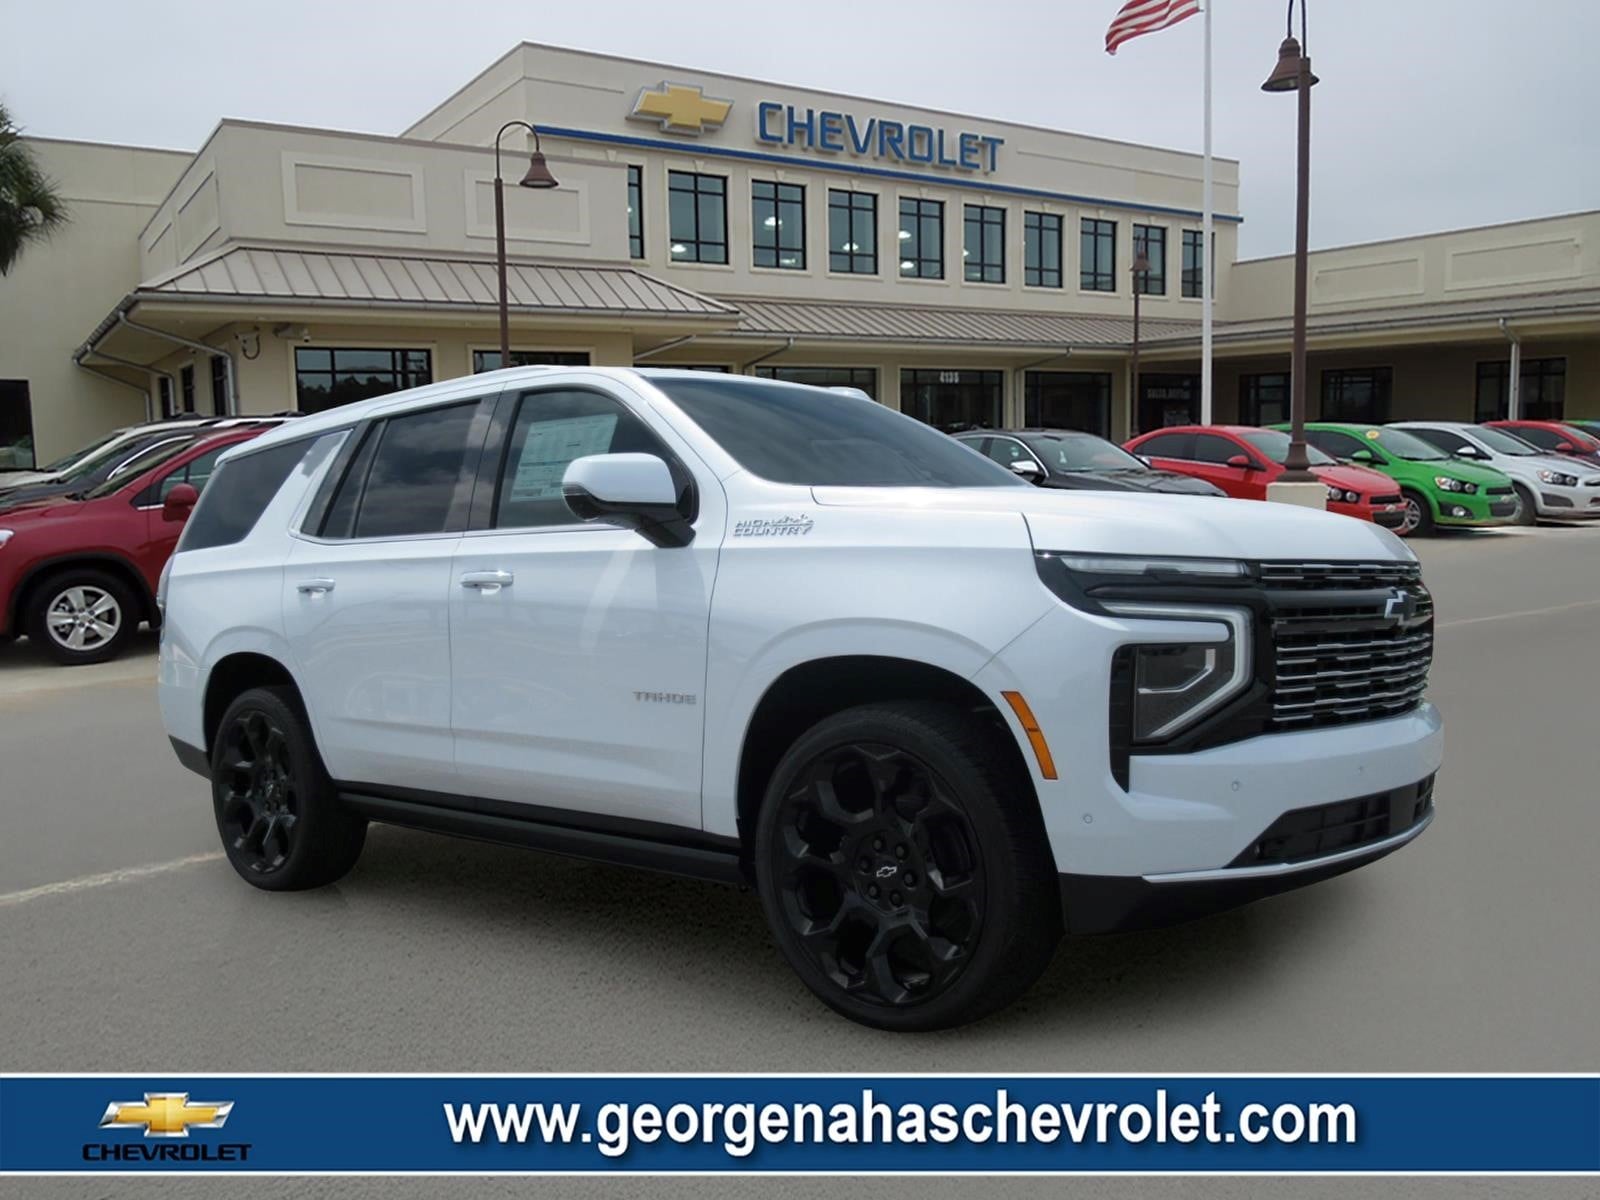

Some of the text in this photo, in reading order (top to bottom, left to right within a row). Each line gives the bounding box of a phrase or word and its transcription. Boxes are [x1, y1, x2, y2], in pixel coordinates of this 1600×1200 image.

[757, 101, 1005, 173] CHEVROLET
[734, 526, 814, 537] COUNTRY
[632, 691, 697, 704] TAHOE
